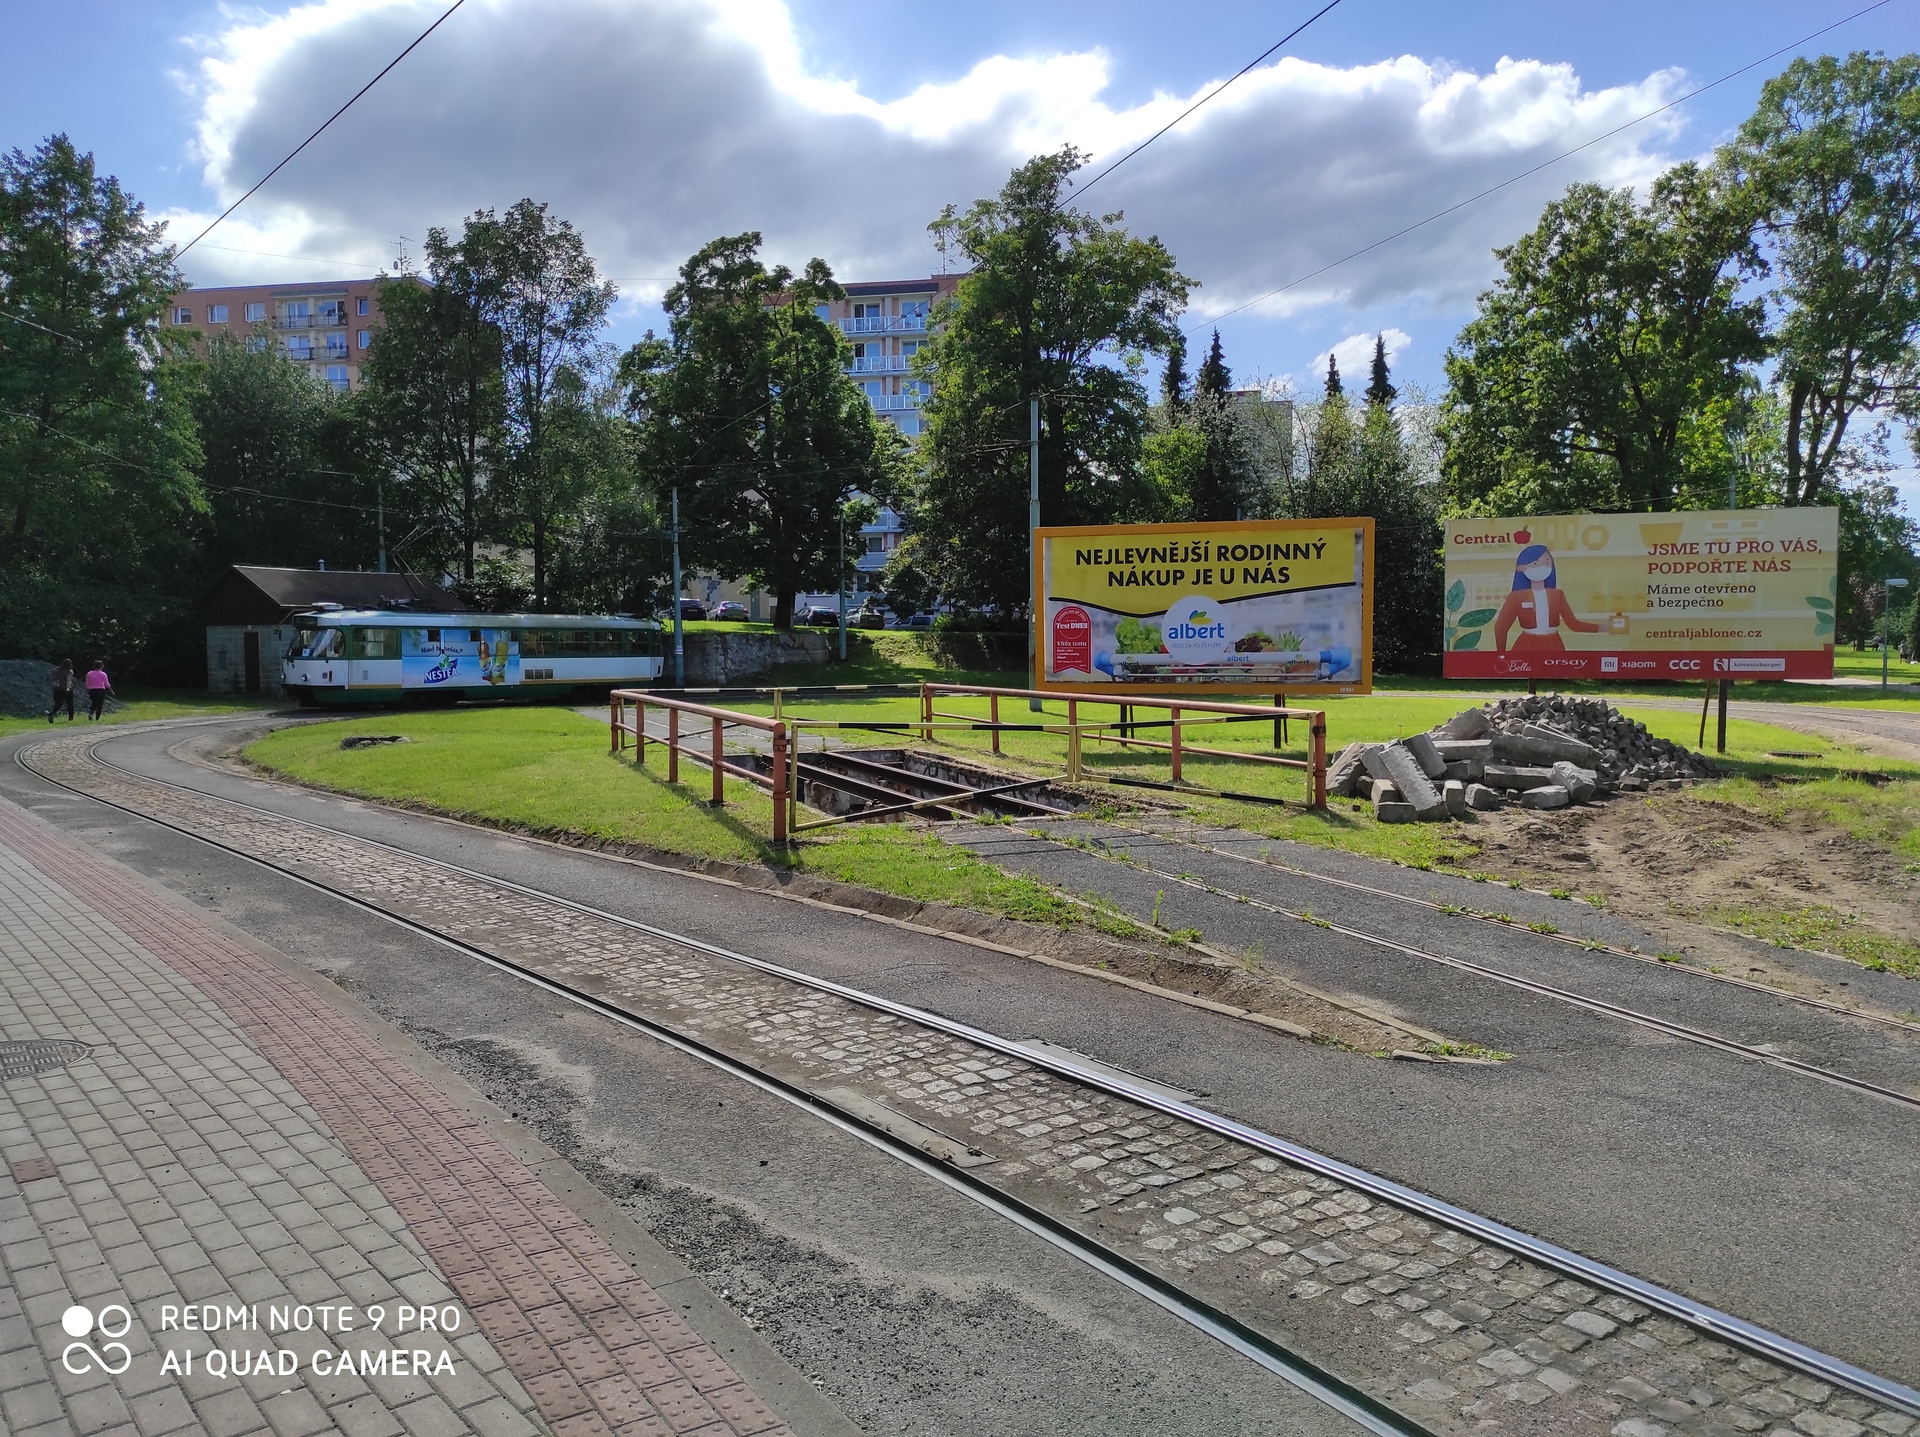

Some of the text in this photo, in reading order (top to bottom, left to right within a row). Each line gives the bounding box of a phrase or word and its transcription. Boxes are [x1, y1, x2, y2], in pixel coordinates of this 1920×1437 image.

[1454, 532, 1511, 544] Central
[1076, 537, 1327, 566] NEJLEVNĚJŠÍ RODINNÝ
[1647, 537, 1823, 556] JSME TU PRO VÁS,
[1647, 556, 1791, 574] PODPOŘTE NÁS
[1108, 561, 1291, 587] NÁKUP JE U NÁS
[1646, 582, 1756, 595] Máme otevřeno
[1646, 597, 1724, 610] a bezpečno
[1168, 622, 1225, 639] albert
[1645, 628, 1762, 640] centraljablonec.cz
[421, 646, 435, 655] Need
[1509, 662, 1532, 672] Bella
[1544, 659, 1589, 669] orsay
[1668, 660, 1701, 670] CCC
[424, 668, 458, 681] NESTEA
